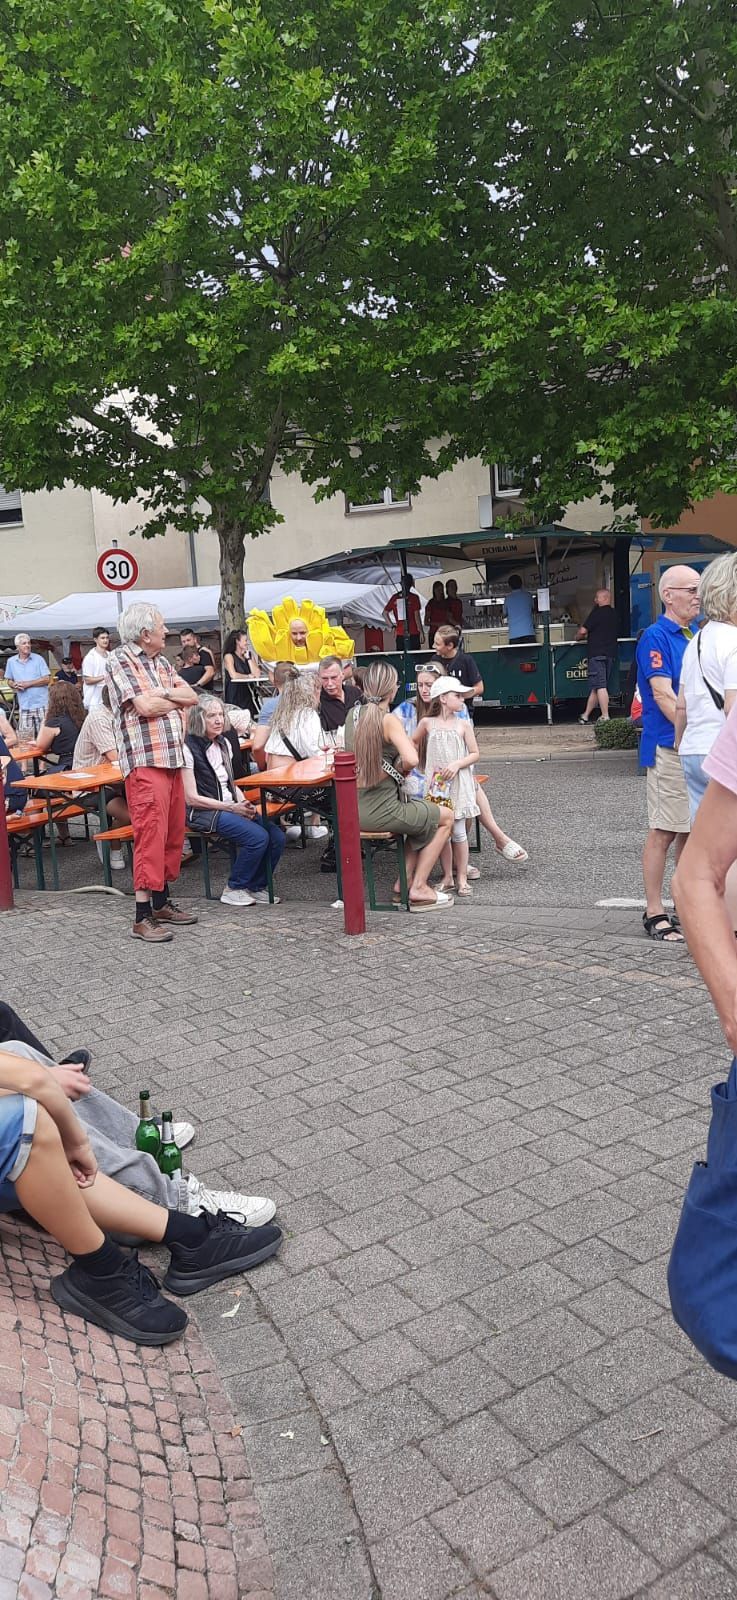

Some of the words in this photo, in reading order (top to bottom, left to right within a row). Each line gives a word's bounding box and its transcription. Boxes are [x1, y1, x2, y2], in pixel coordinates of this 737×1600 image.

[481, 545, 517, 554] EICHBAUM
[106, 560, 130, 579] 30
[649, 650, 663, 668] 3
